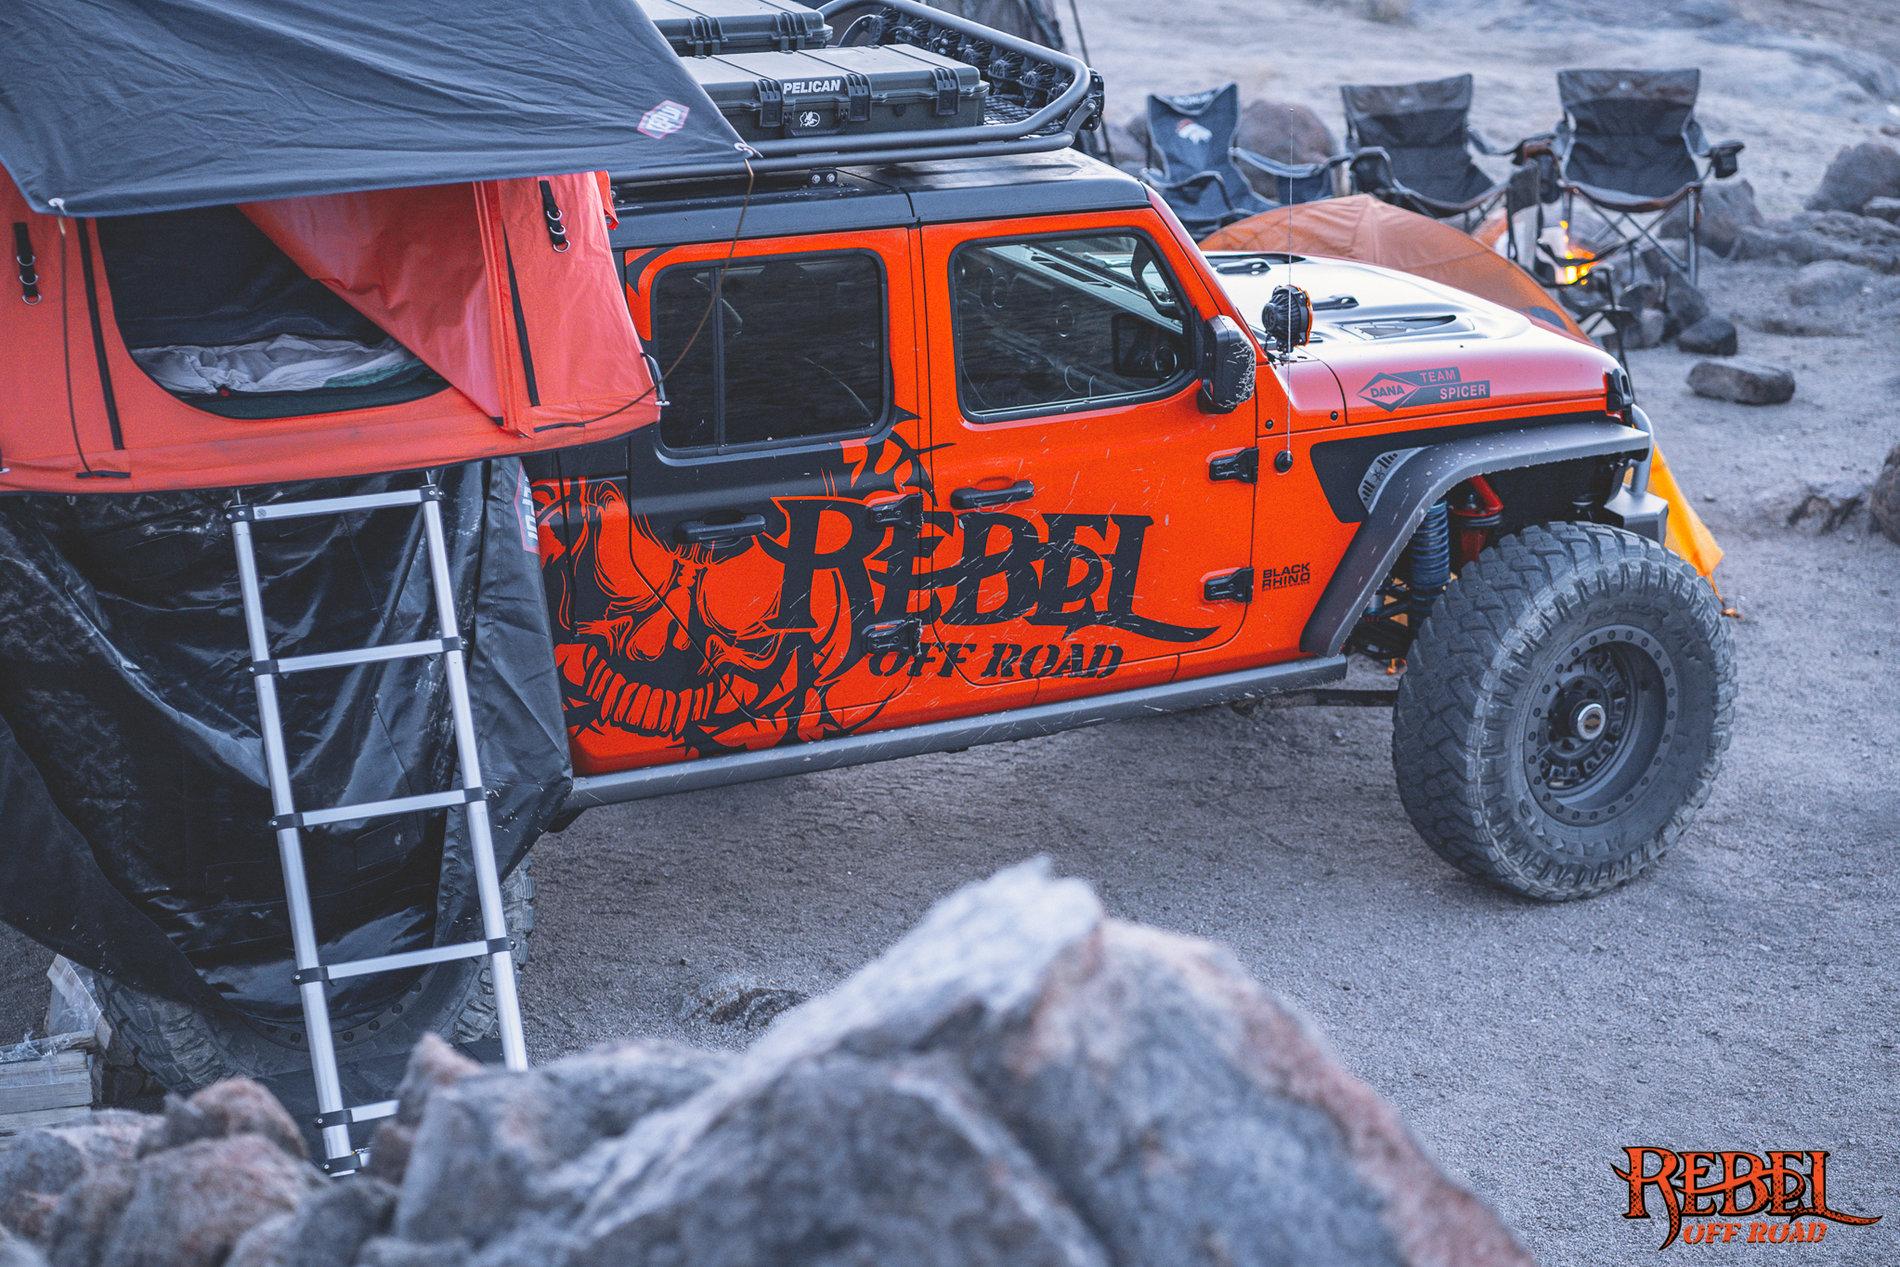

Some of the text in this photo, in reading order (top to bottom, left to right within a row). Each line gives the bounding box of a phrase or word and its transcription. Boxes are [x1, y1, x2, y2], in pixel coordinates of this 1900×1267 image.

[783, 80, 840, 94] PELICAN
[1419, 370, 1456, 383] TEAM
[1370, 385, 1405, 398] DANA
[1440, 384, 1487, 399] SPICER
[1263, 562, 1310, 578] BLACK
[763, 500, 1221, 668] REBEL
[1262, 572, 1310, 589] RHINO
[868, 642, 1123, 678] OFF ROAD
